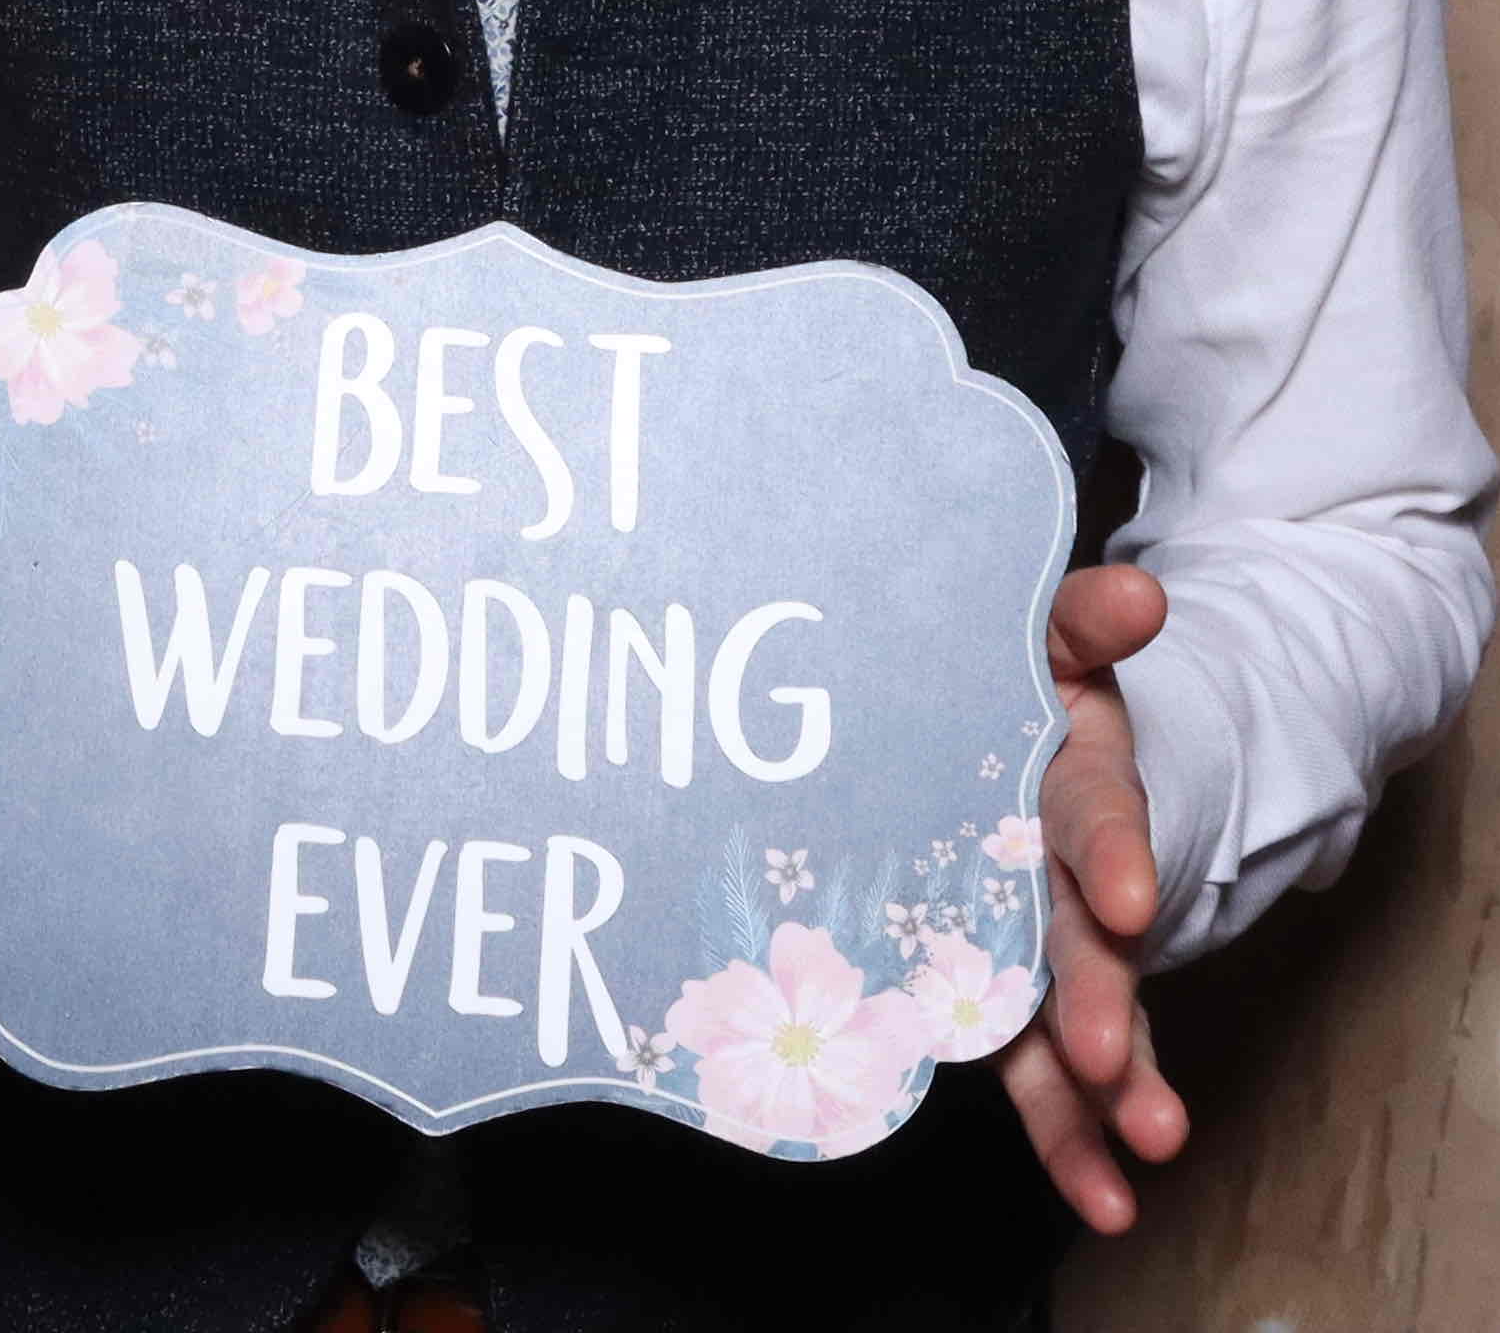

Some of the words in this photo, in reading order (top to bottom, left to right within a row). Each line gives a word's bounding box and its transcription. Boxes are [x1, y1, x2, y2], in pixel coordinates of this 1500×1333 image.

[310, 311, 672, 541] BEST
[114, 559, 832, 789] WEDDING
[262, 822, 630, 1067] EVER
